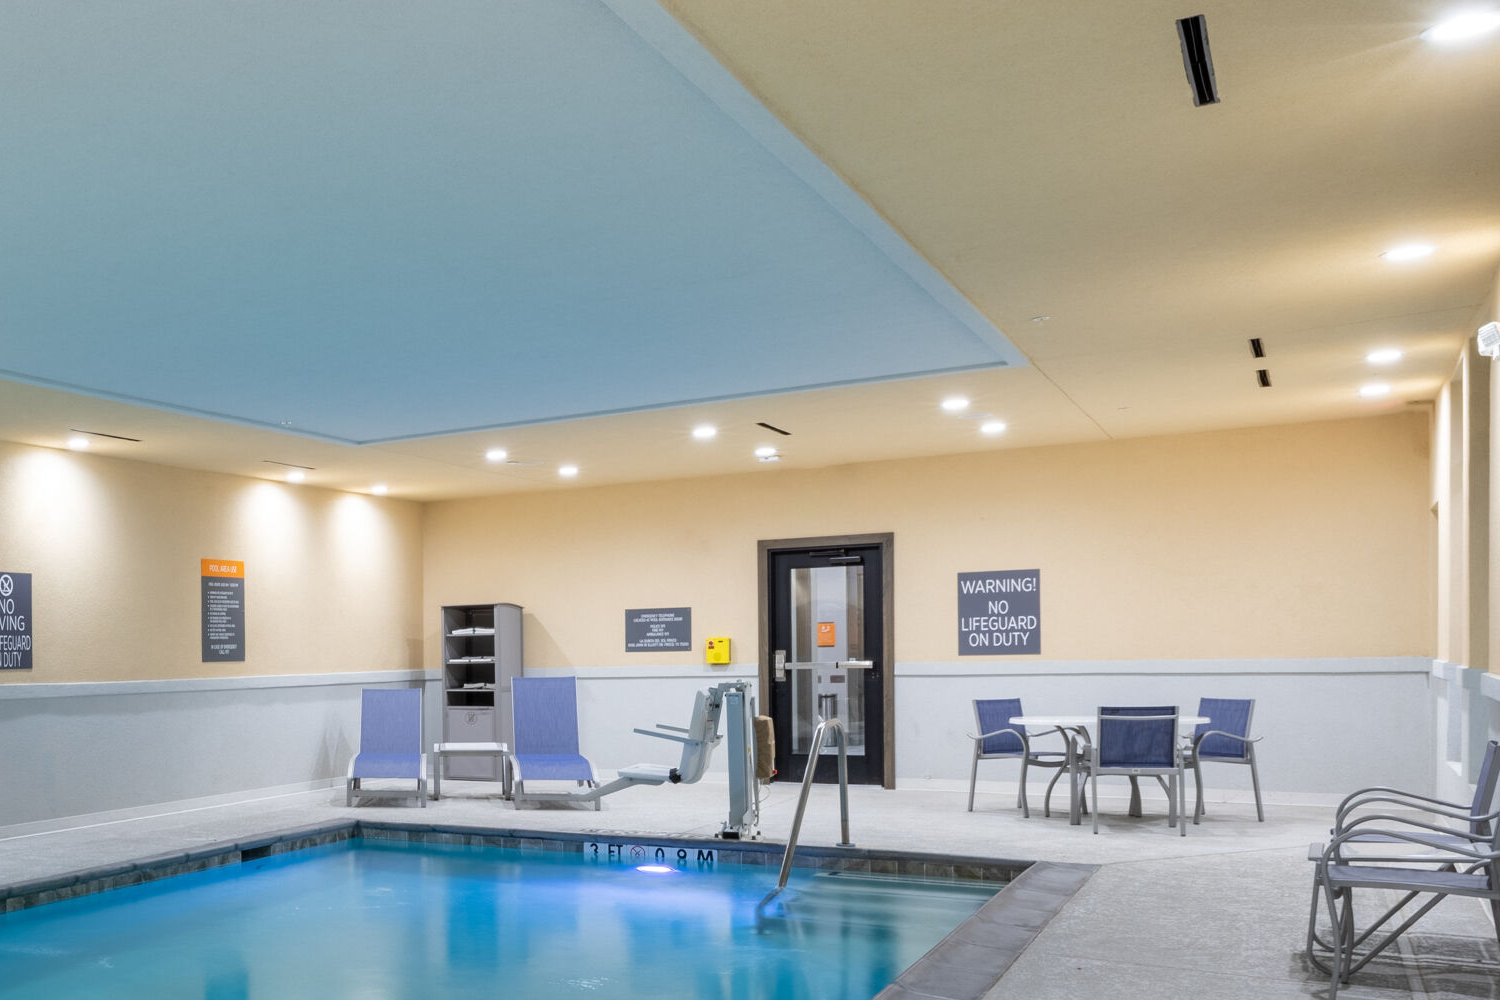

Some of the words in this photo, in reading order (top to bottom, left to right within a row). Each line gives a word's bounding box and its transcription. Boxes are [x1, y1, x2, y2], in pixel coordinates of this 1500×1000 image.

[960, 577, 1037, 595] WARNING!
[988, 600, 1009, 615] NO
[961, 615, 1037, 631] LIFEGUARD
[968, 632, 989, 647] ON
[993, 631, 1030, 646] DUTY
[3, 652, 22, 667] DUTY
[608, 844, 623, 855] FT
[697, 850, 714, 861] M
